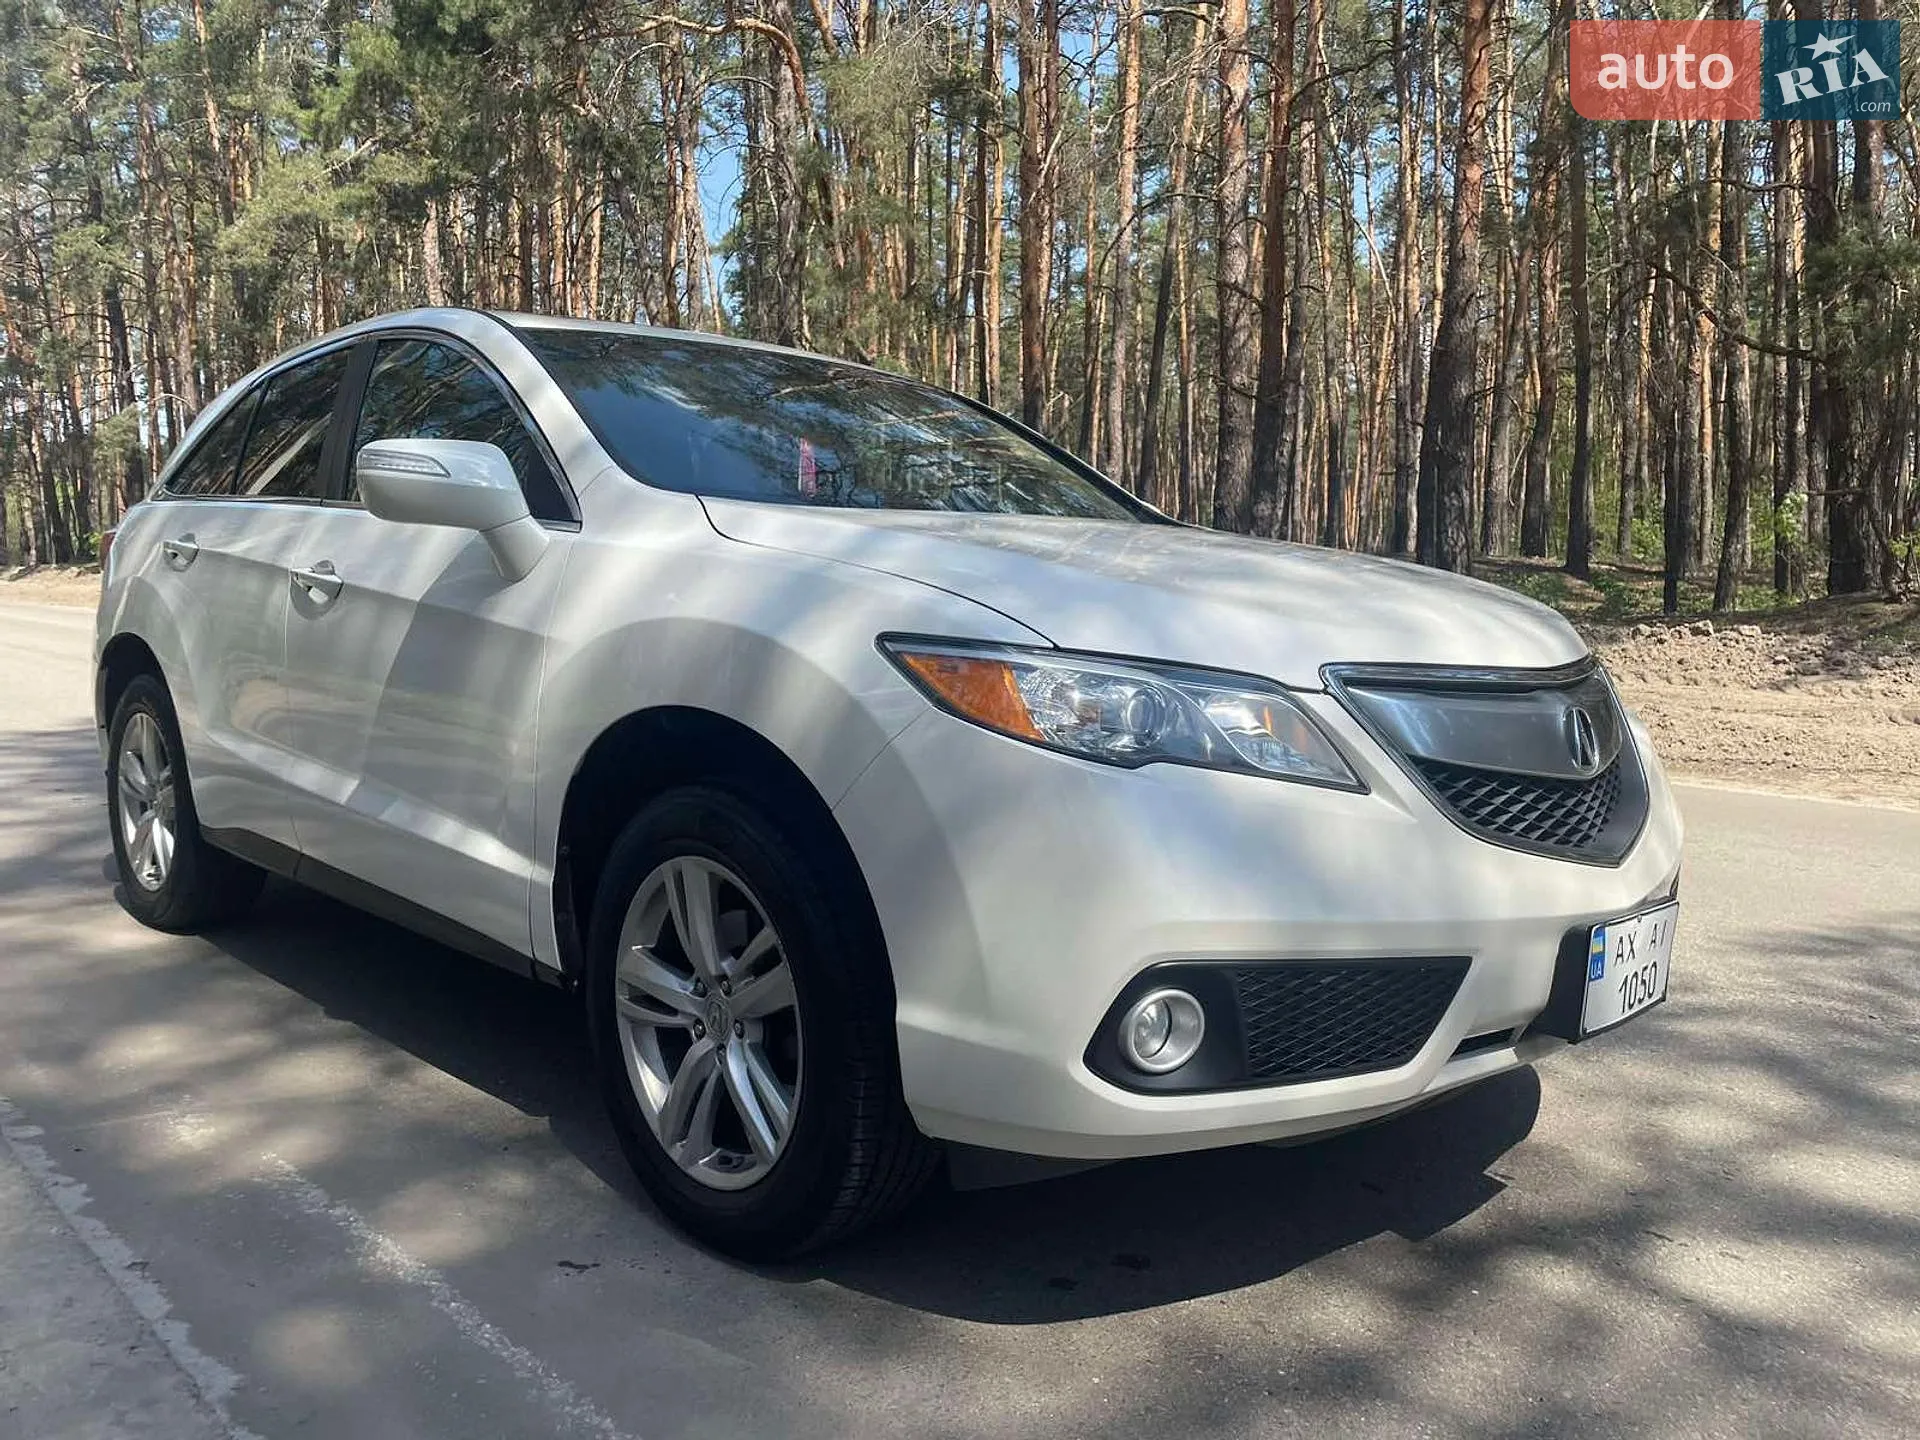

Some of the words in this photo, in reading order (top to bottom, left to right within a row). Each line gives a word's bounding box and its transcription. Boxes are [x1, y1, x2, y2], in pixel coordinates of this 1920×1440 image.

[1614, 931, 1637, 967] AX
[1648, 920, 1668, 951] AI
[1591, 963, 1602, 978] UA
[1619, 961, 1658, 1013] 1050
